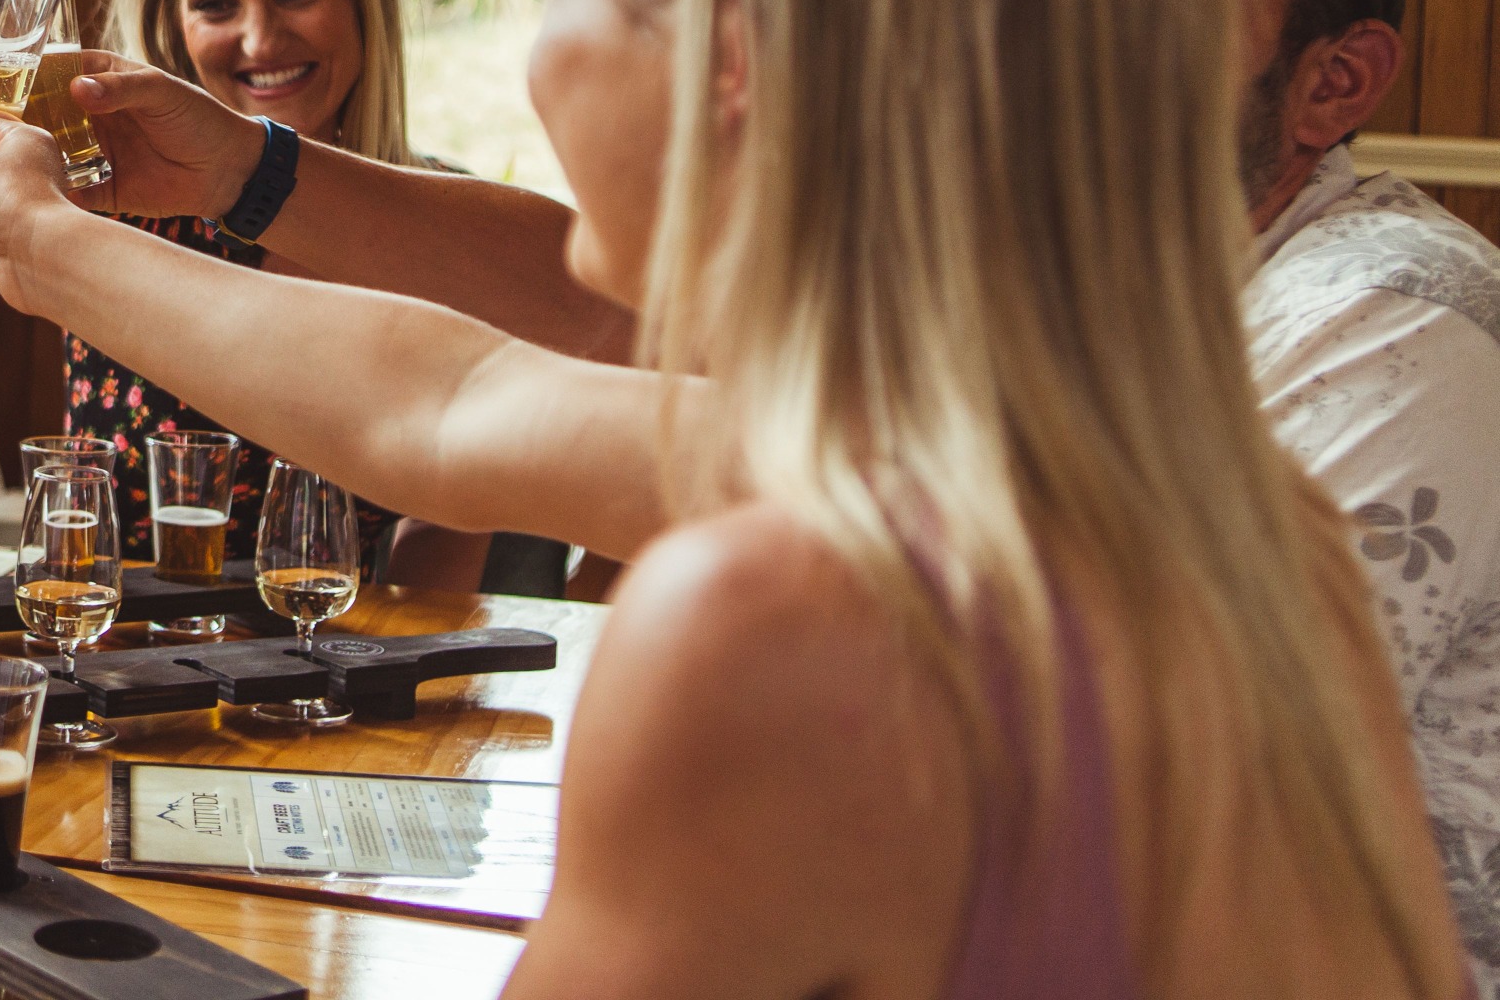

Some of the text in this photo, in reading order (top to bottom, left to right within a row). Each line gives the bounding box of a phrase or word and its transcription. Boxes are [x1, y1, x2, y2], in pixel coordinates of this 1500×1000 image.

[192, 792, 222, 837] ALTITUDE
[273, 804, 292, 834] CRAFT BEER
